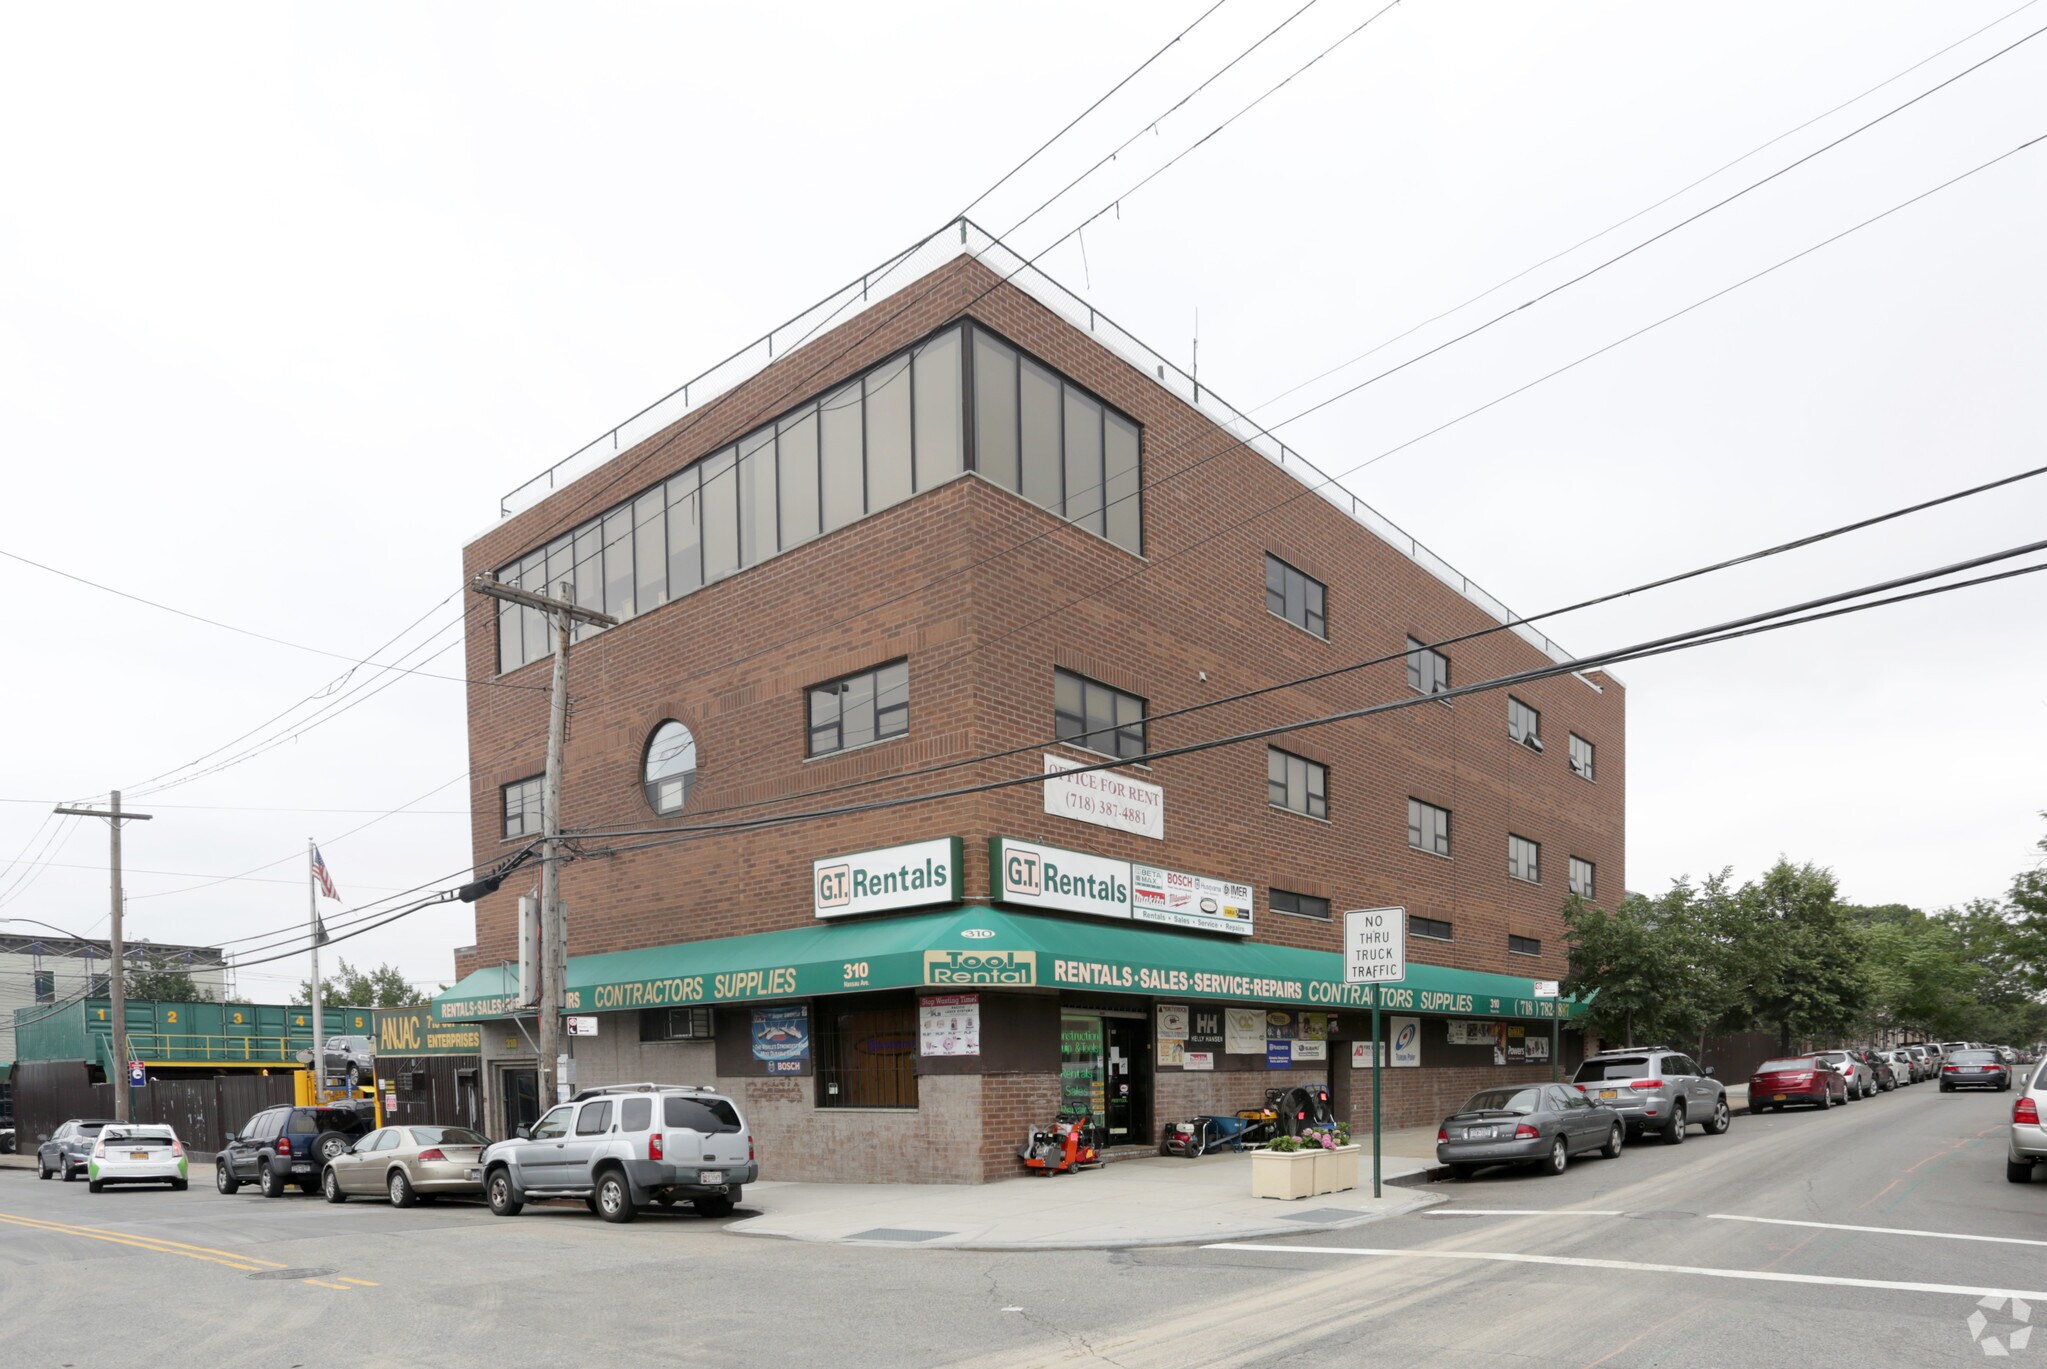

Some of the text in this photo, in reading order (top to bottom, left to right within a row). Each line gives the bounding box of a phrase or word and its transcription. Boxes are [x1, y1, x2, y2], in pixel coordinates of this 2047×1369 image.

[1049, 763, 1161, 807] OFFICE FOR RENT
[1065, 793, 1147, 825] (718) 387-4881
[820, 858, 947, 901] G.T. Rentals
[1007, 856, 1127, 904] G.T. Rentals
[1141, 869, 1162, 878] BETA
[1141, 877, 1157, 885] MAX
[1167, 873, 1193, 888] BOSCH
[1230, 885, 1248, 897] IMER
[1143, 911, 1245, 933] Rentals Sales Service Repairs
[1365, 915, 1383, 927] NO
[964, 929, 993, 939] 310
[1360, 931, 1390, 945] THRU
[946, 952, 1015, 968] Tool
[1356, 948, 1393, 961] TRUCK
[843, 962, 869, 979] 310
[935, 968, 1026, 983] Rental
[1352, 964, 1397, 979] TRAFFIC
[1054, 960, 1302, 1000] RENTALS SALES SERVICE REPAIRS
[594, 976, 703, 1008] CONTRACTORS
[714, 967, 796, 999] SUPPLIES
[922, 995, 977, 1006] Stop Wasting Time!
[1308, 981, 1473, 1012] CONTRATORS SUPPLIES
[441, 1001, 475, 1018] RENTALS
[476, 998, 502, 1015] SALES
[1490, 998, 1500, 1009] 310
[97, 1009, 105, 1020] 1
[167, 1010, 178, 1023] 2
[233, 1013, 243, 1024] 3
[296, 1015, 305, 1027] 4
[355, 1017, 364, 1028] 5
[381, 1016, 420, 1050] ANJAC
[1061, 1031, 1099, 1041] nstruction
[427, 1033, 480, 1048] ENTERPRISES
[1508, 1046, 1525, 1056] Powers
[777, 1062, 800, 1070] BOSCH
[1065, 1085, 1088, 1096] Sales
